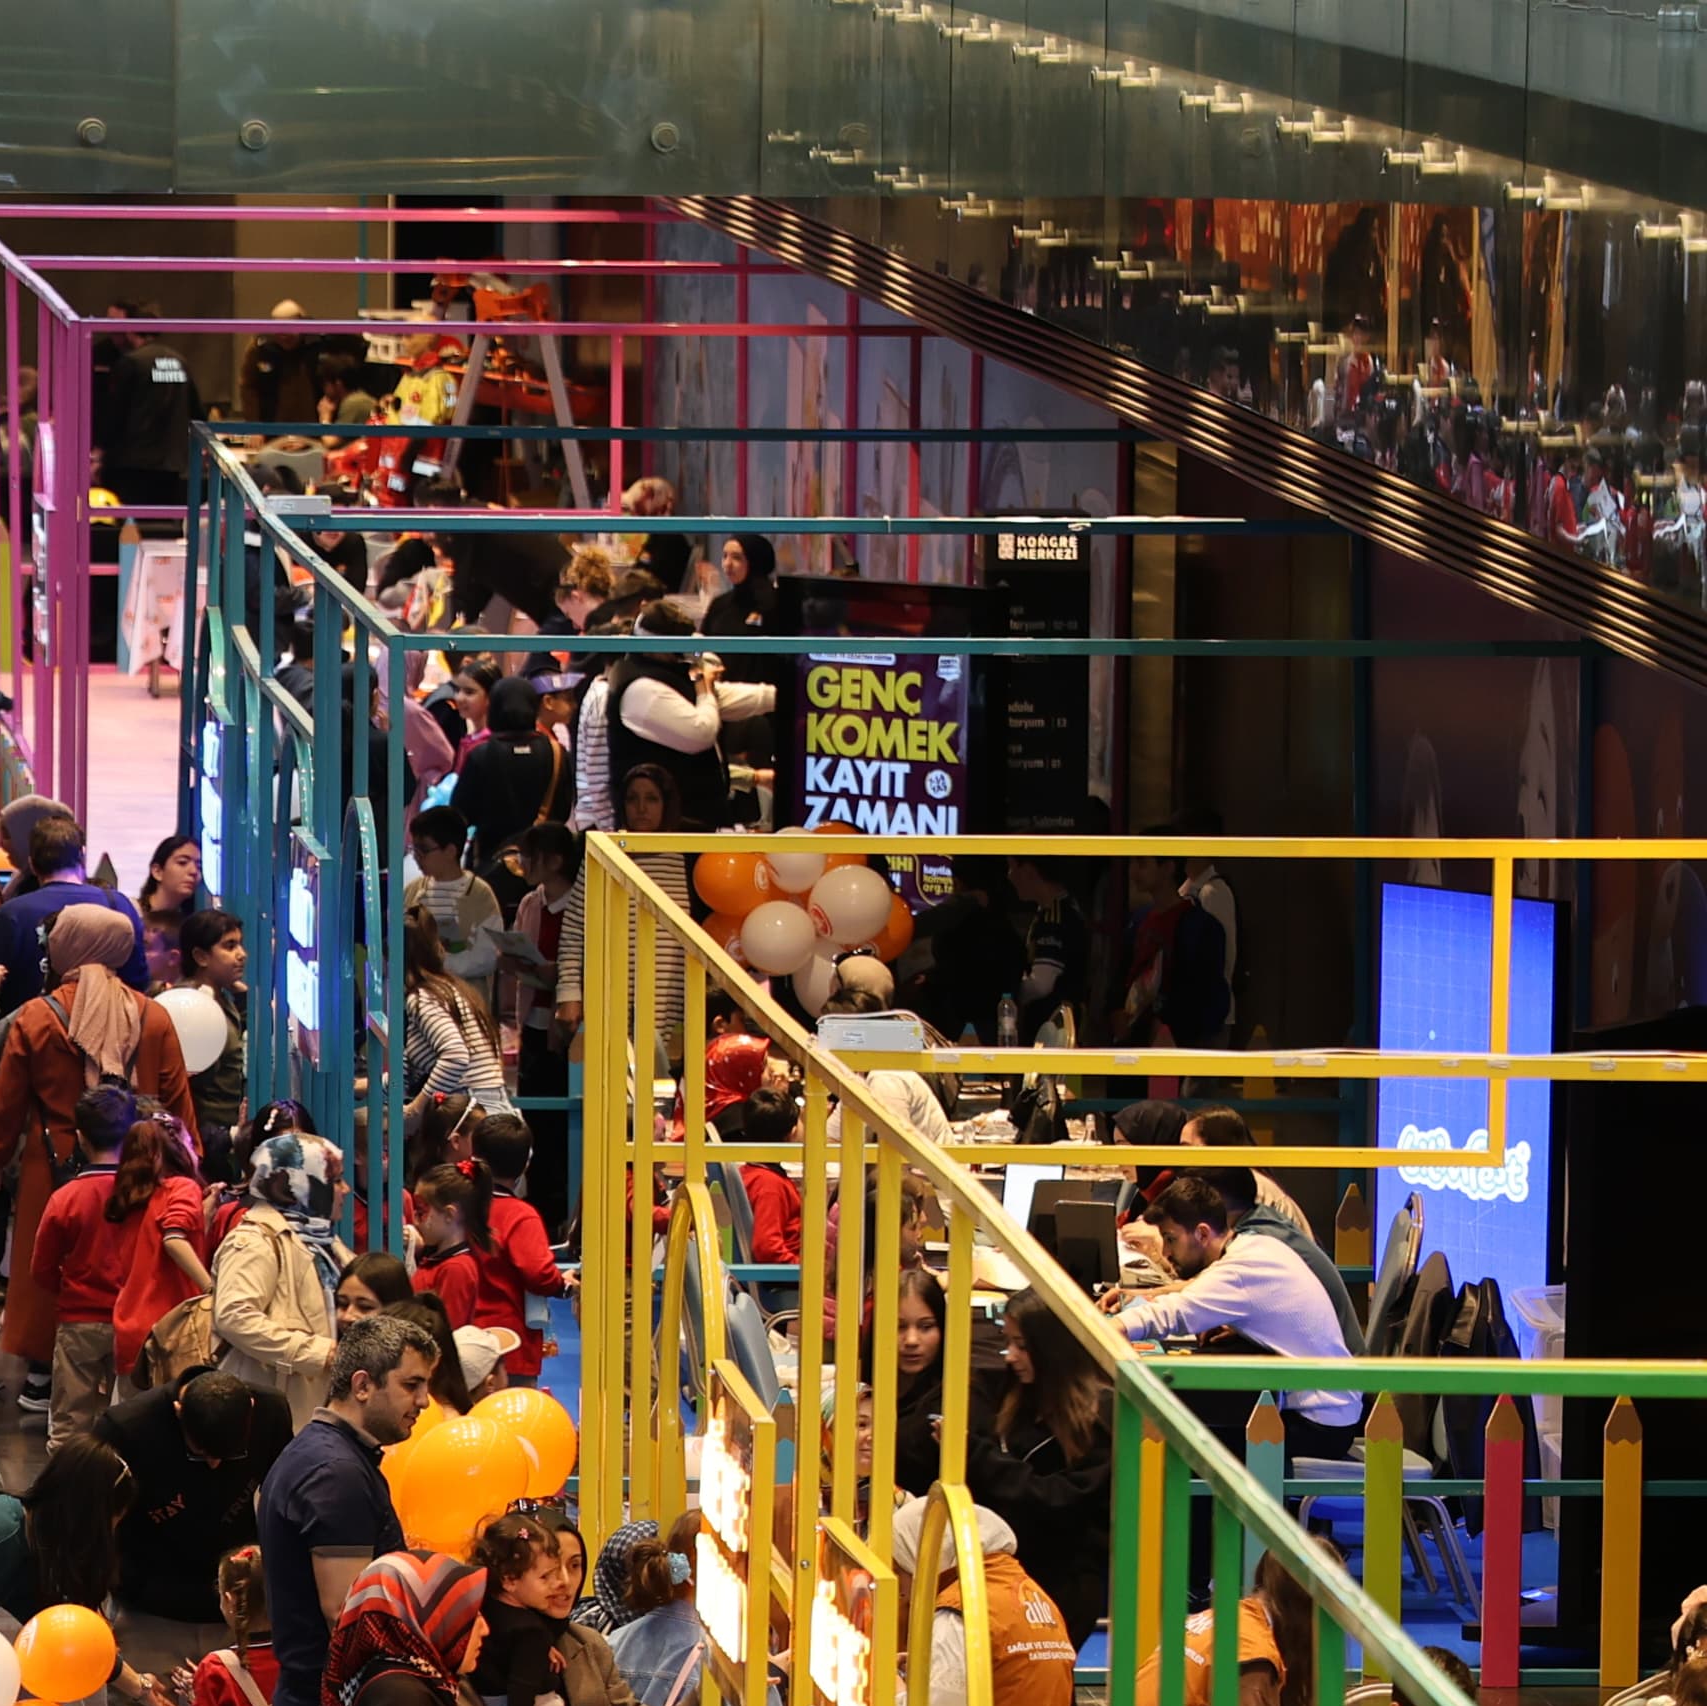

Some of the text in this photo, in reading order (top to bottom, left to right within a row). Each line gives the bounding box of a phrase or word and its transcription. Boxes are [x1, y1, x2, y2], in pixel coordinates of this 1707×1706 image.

[806, 666, 922, 716] GENÇ
[806, 712, 960, 764] KOMEK
[805, 755, 911, 798] KAYIT
[802, 795, 959, 835] ZAMANI
[1024, 1591, 1056, 1625] aile
